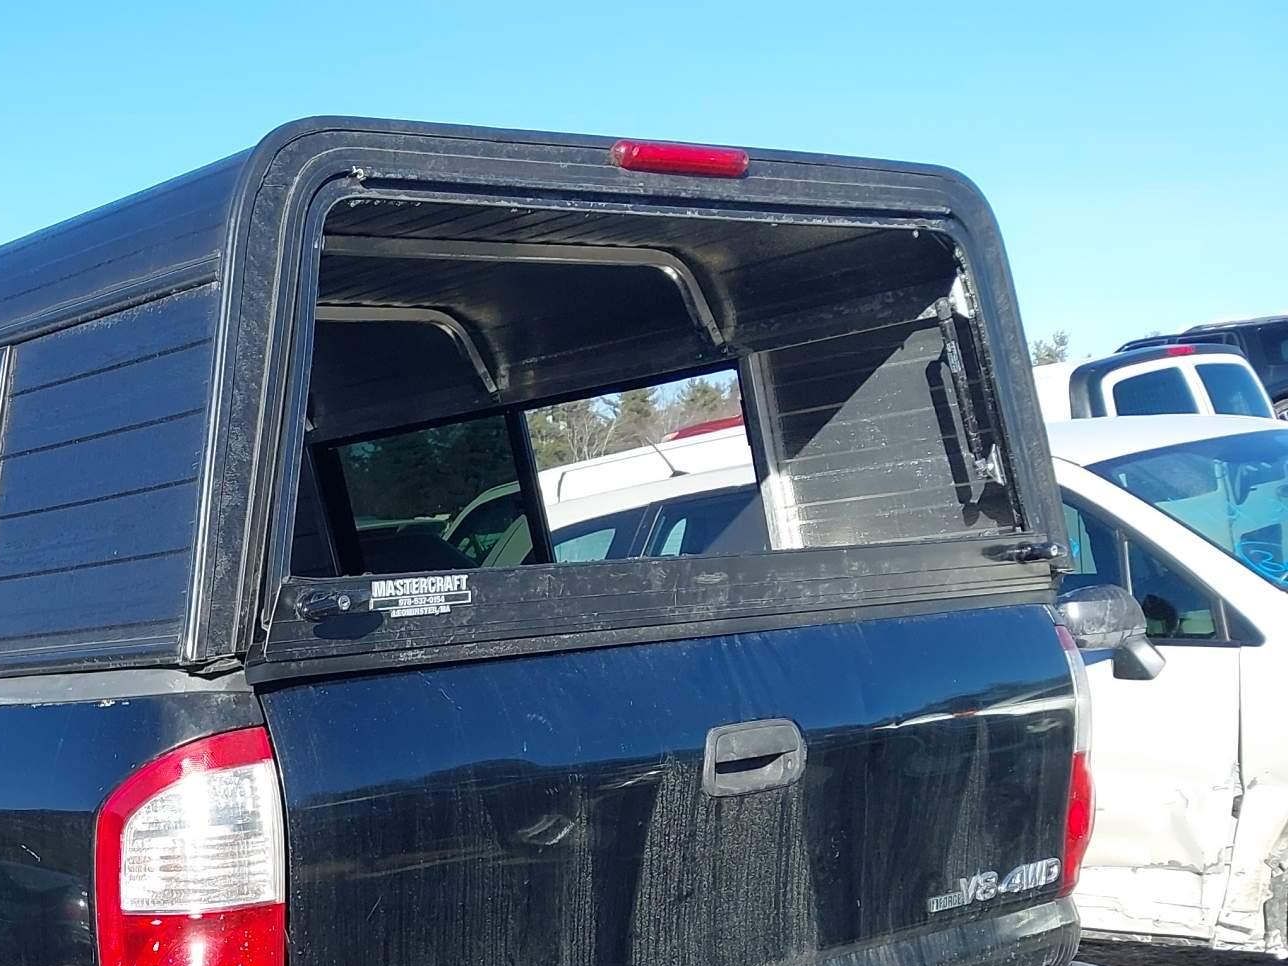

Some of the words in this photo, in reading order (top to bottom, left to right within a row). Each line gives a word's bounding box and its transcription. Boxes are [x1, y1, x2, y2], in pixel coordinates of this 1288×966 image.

[371, 575, 469, 598] MASTERCRAFT
[960, 869, 999, 906] V8
[998, 858, 1062, 893] 4WD
